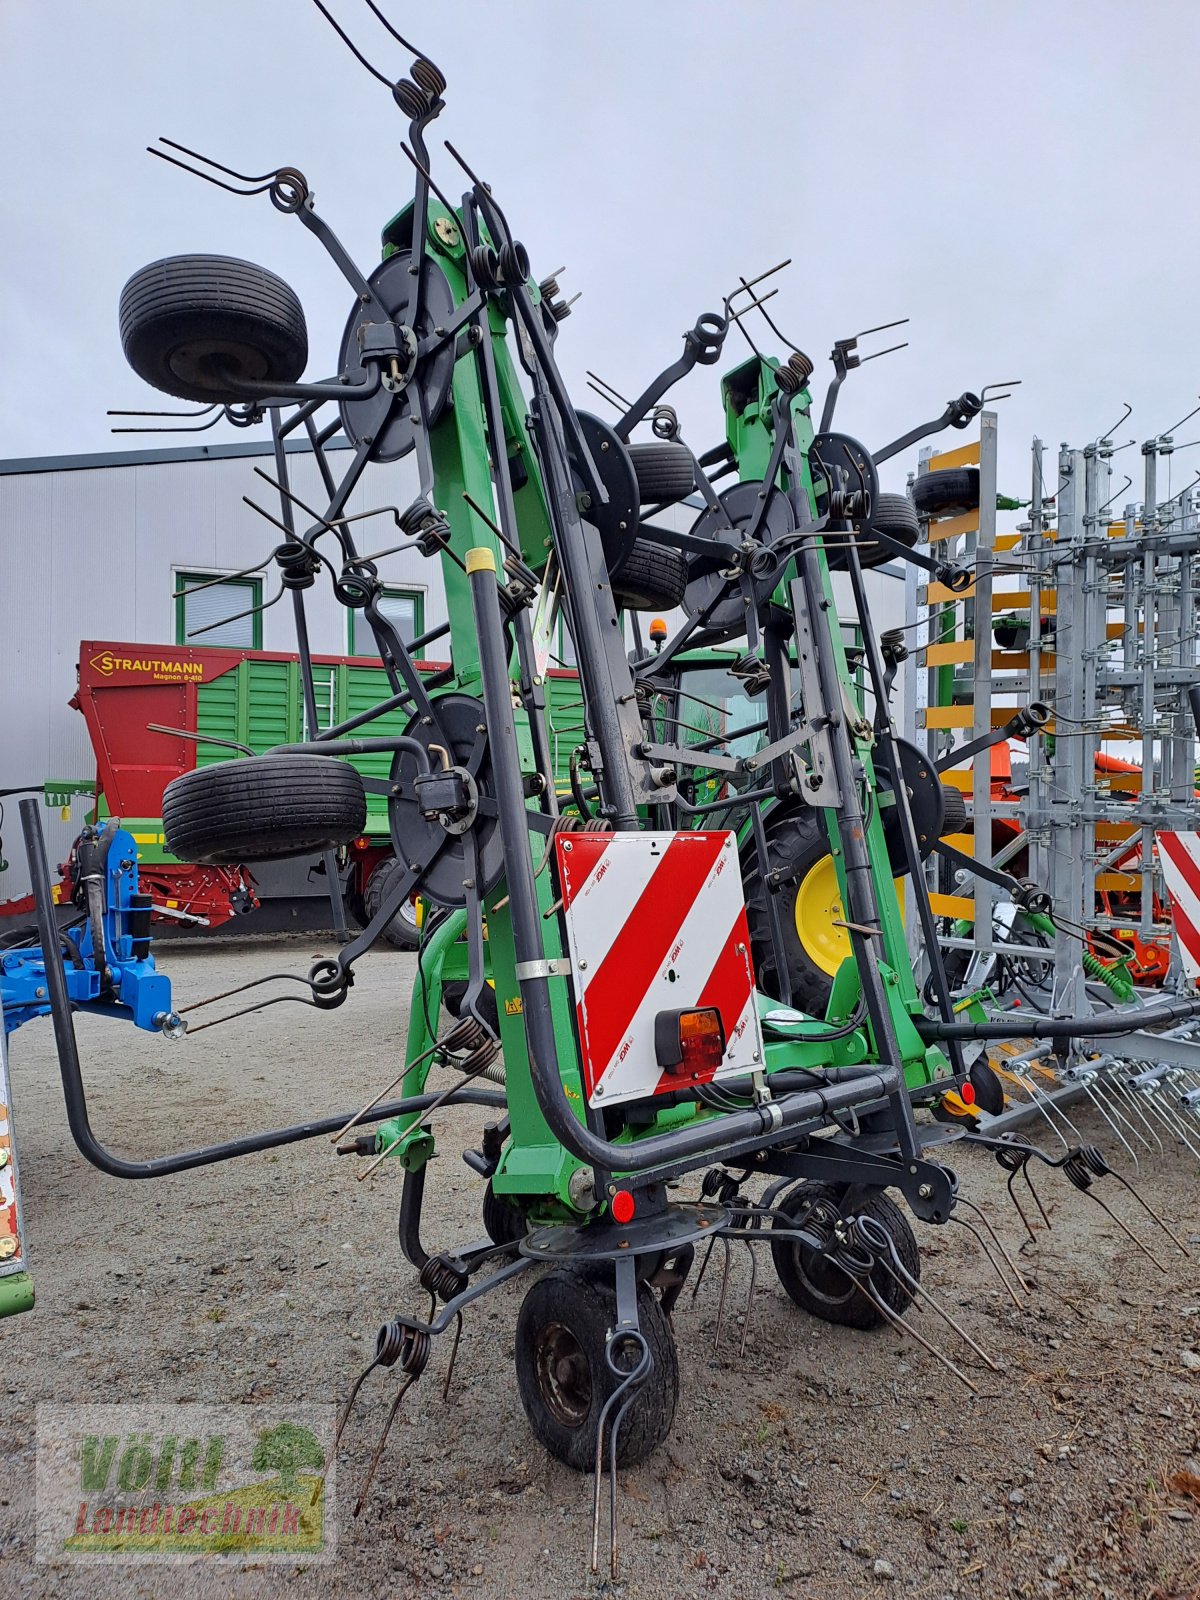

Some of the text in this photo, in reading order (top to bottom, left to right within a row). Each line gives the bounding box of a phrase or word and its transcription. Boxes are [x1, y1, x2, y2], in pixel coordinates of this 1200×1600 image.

[101, 657, 203, 675] STRAUTMANN
[153, 673, 181, 681] Magnon
[619, 1042, 630, 1063] WGF
